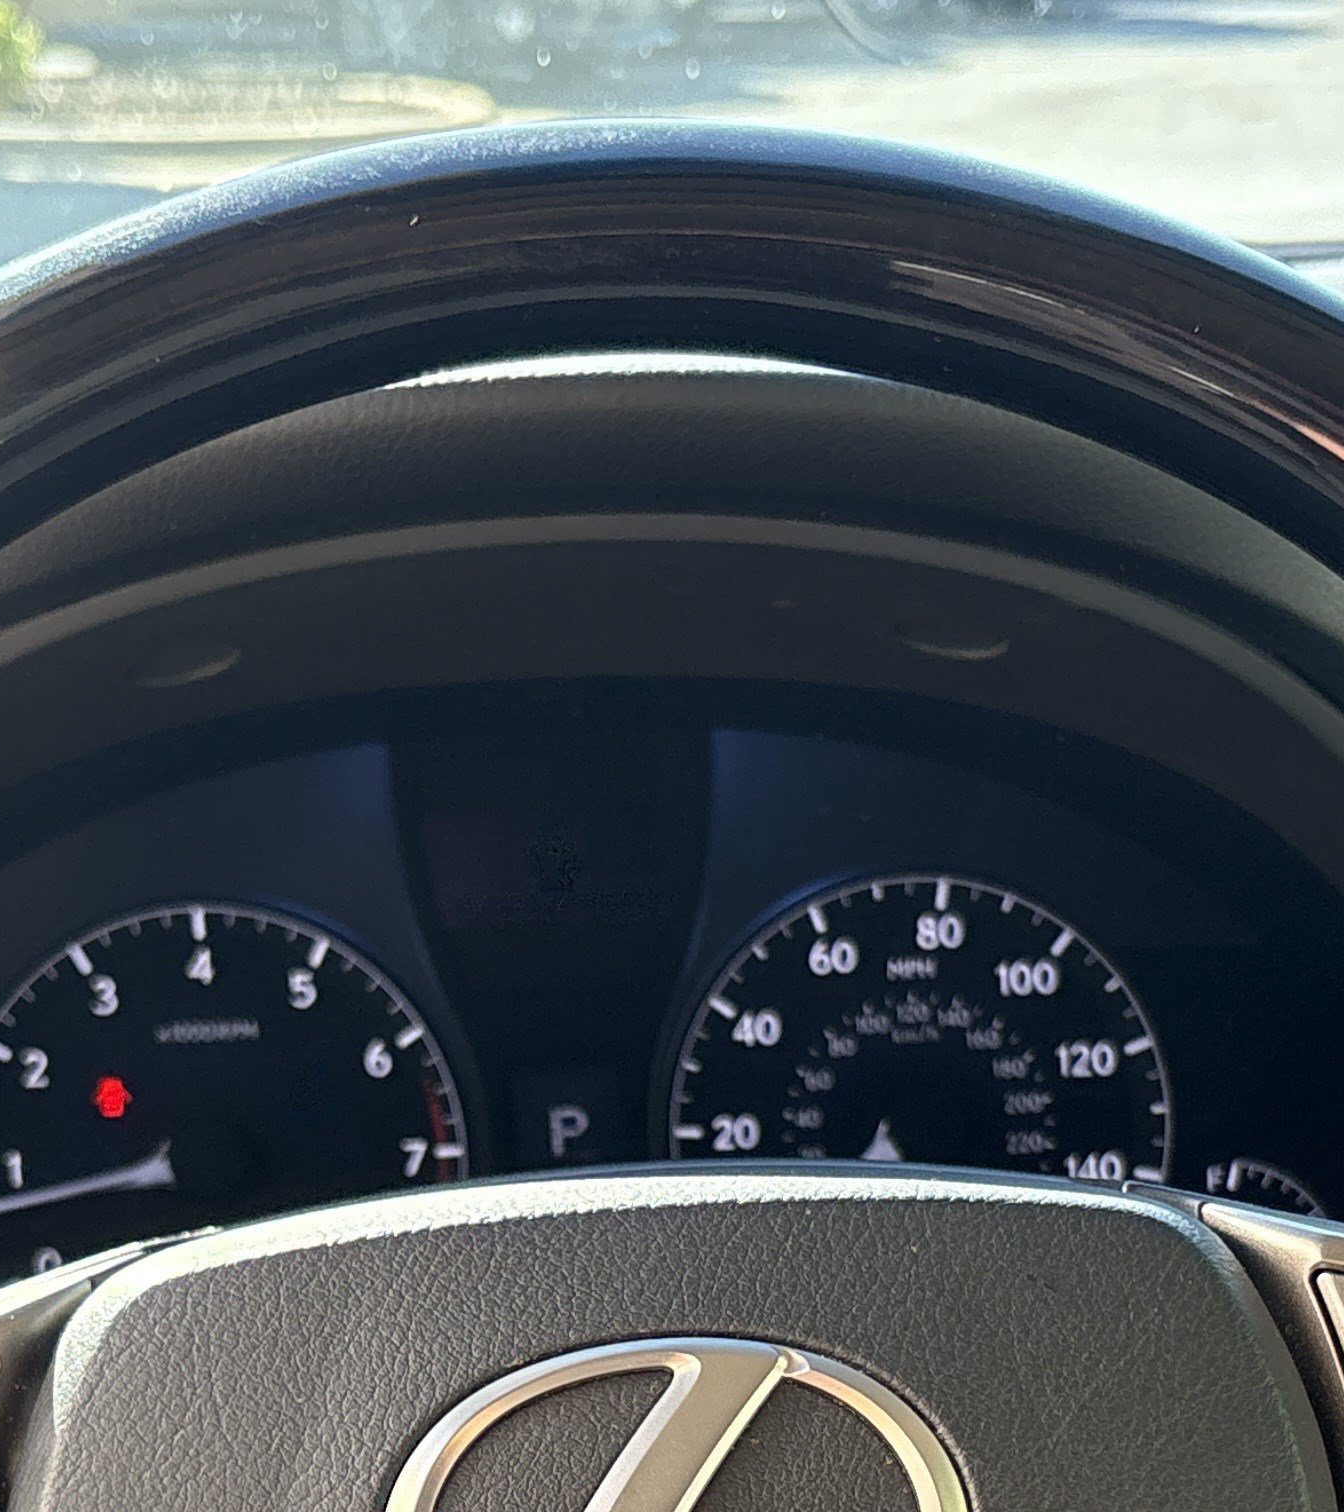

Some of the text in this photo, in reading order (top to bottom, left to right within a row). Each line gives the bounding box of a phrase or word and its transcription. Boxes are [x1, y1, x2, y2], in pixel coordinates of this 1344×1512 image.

[916, 915, 963, 949] 80
[189, 949, 213, 983] 4
[809, 941, 857, 975] 60
[887, 959, 935, 979] MPH
[89, 974, 119, 1015] 3
[287, 968, 318, 1010] 5
[996, 961, 1058, 995] 100
[734, 1013, 780, 1045] 40
[24, 1049, 48, 1088] 2
[365, 1042, 392, 1077] 6
[1057, 1042, 1116, 1077] 120
[550, 1106, 588, 1156] P
[712, 1115, 759, 1150] 20
[7, 1153, 22, 1187] 1
[403, 1139, 427, 1176] 7
[1067, 1153, 1124, 1180] 140
[1207, 1167, 1222, 1191] F
